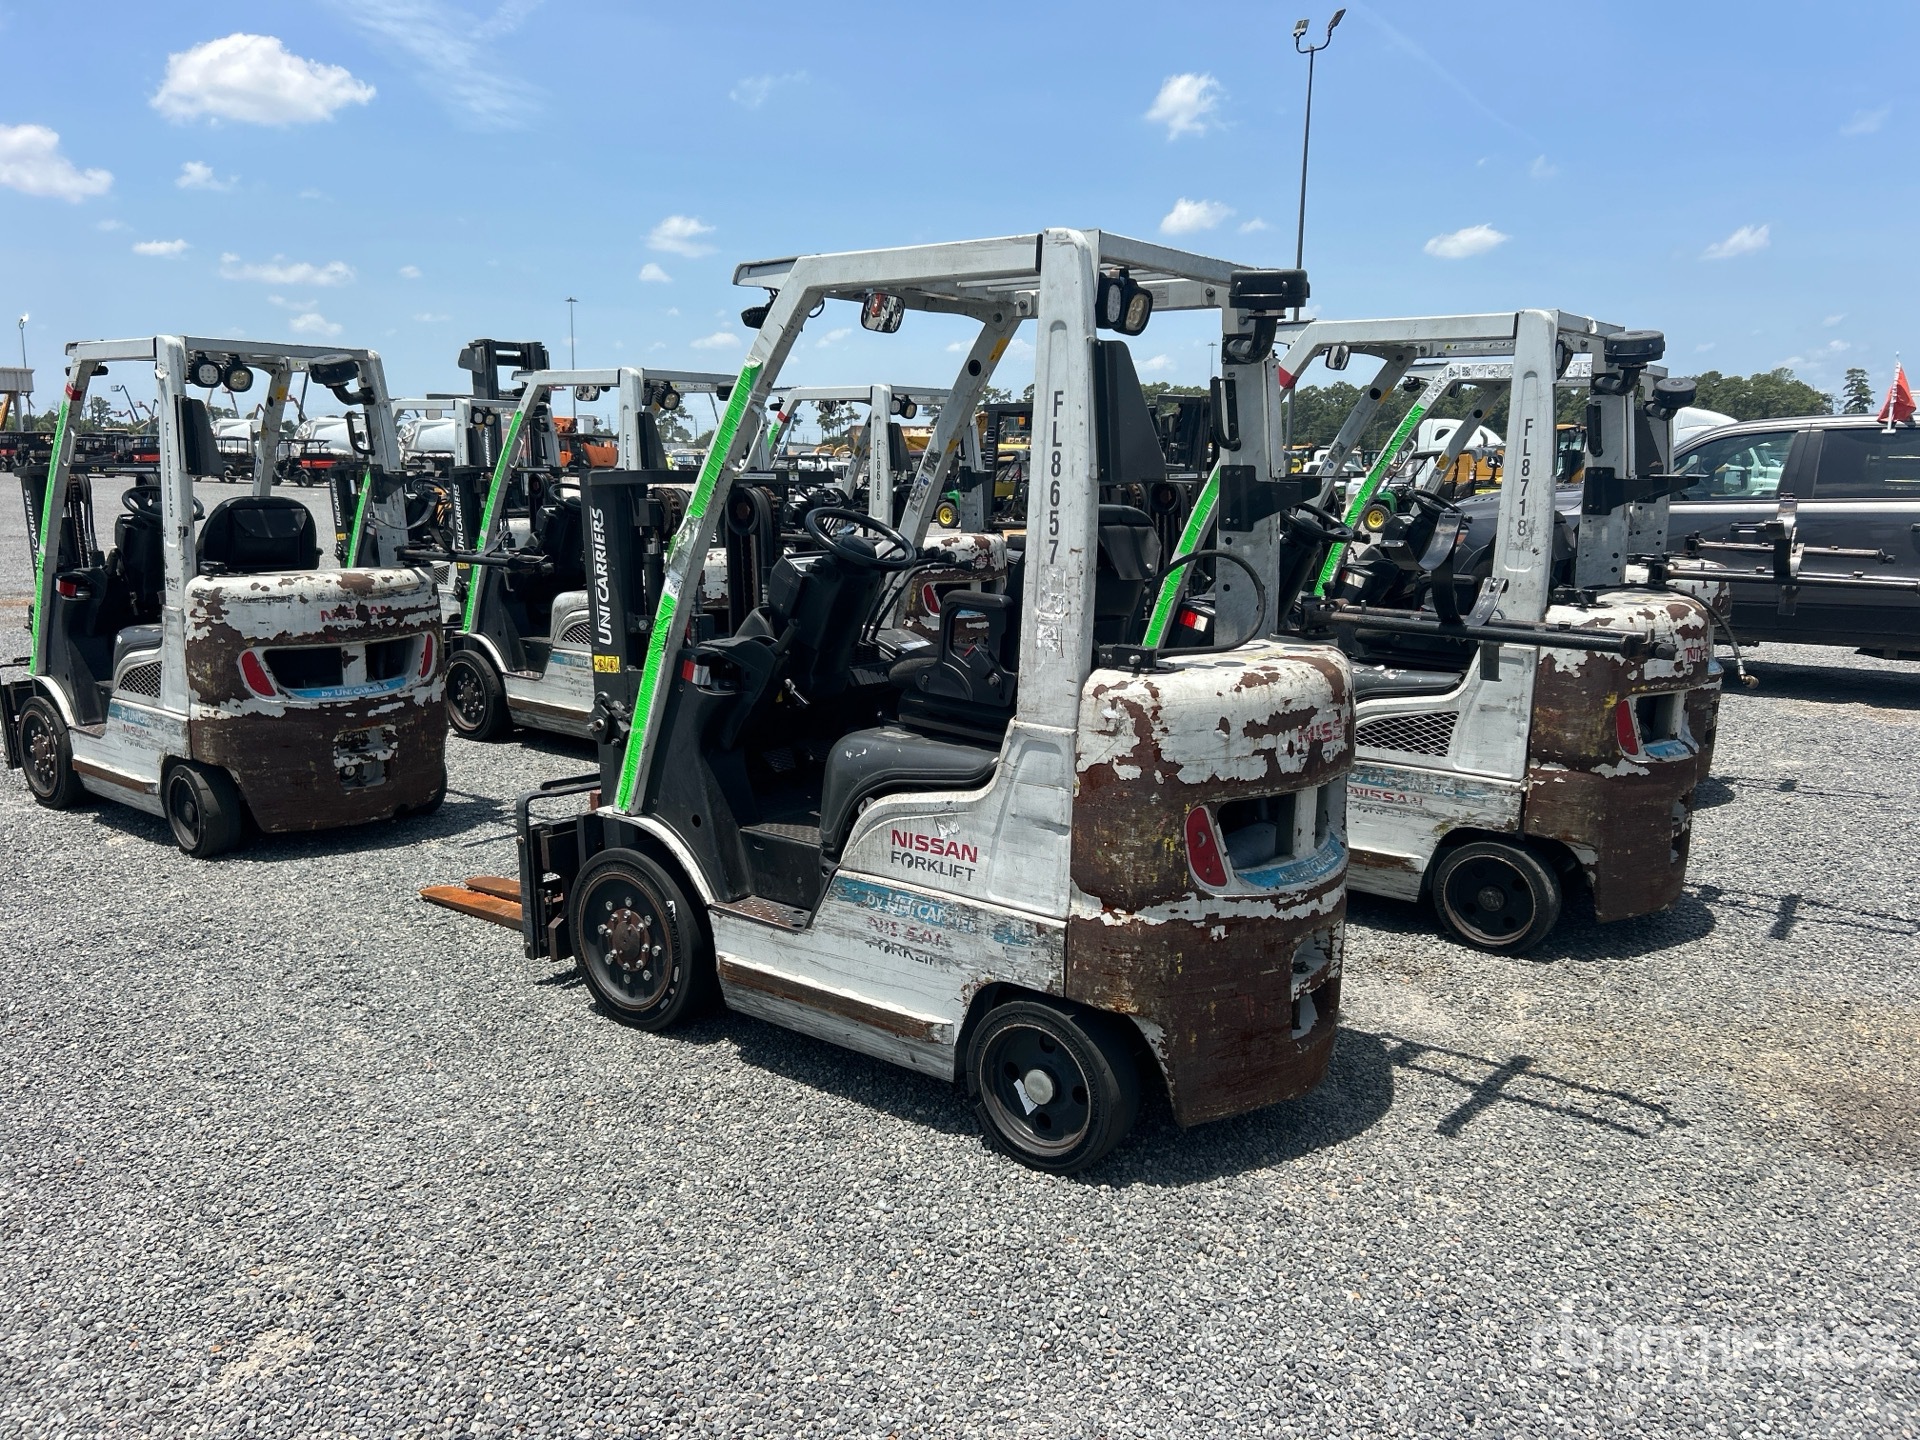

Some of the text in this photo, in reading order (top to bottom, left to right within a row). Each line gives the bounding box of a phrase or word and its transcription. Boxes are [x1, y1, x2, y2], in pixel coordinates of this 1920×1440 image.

[1049, 390, 1064, 565] FL8657
[1517, 418, 1534, 537] FL8718
[890, 850, 976, 882] FORKLIFT
[891, 829, 978, 864] NISSAN
